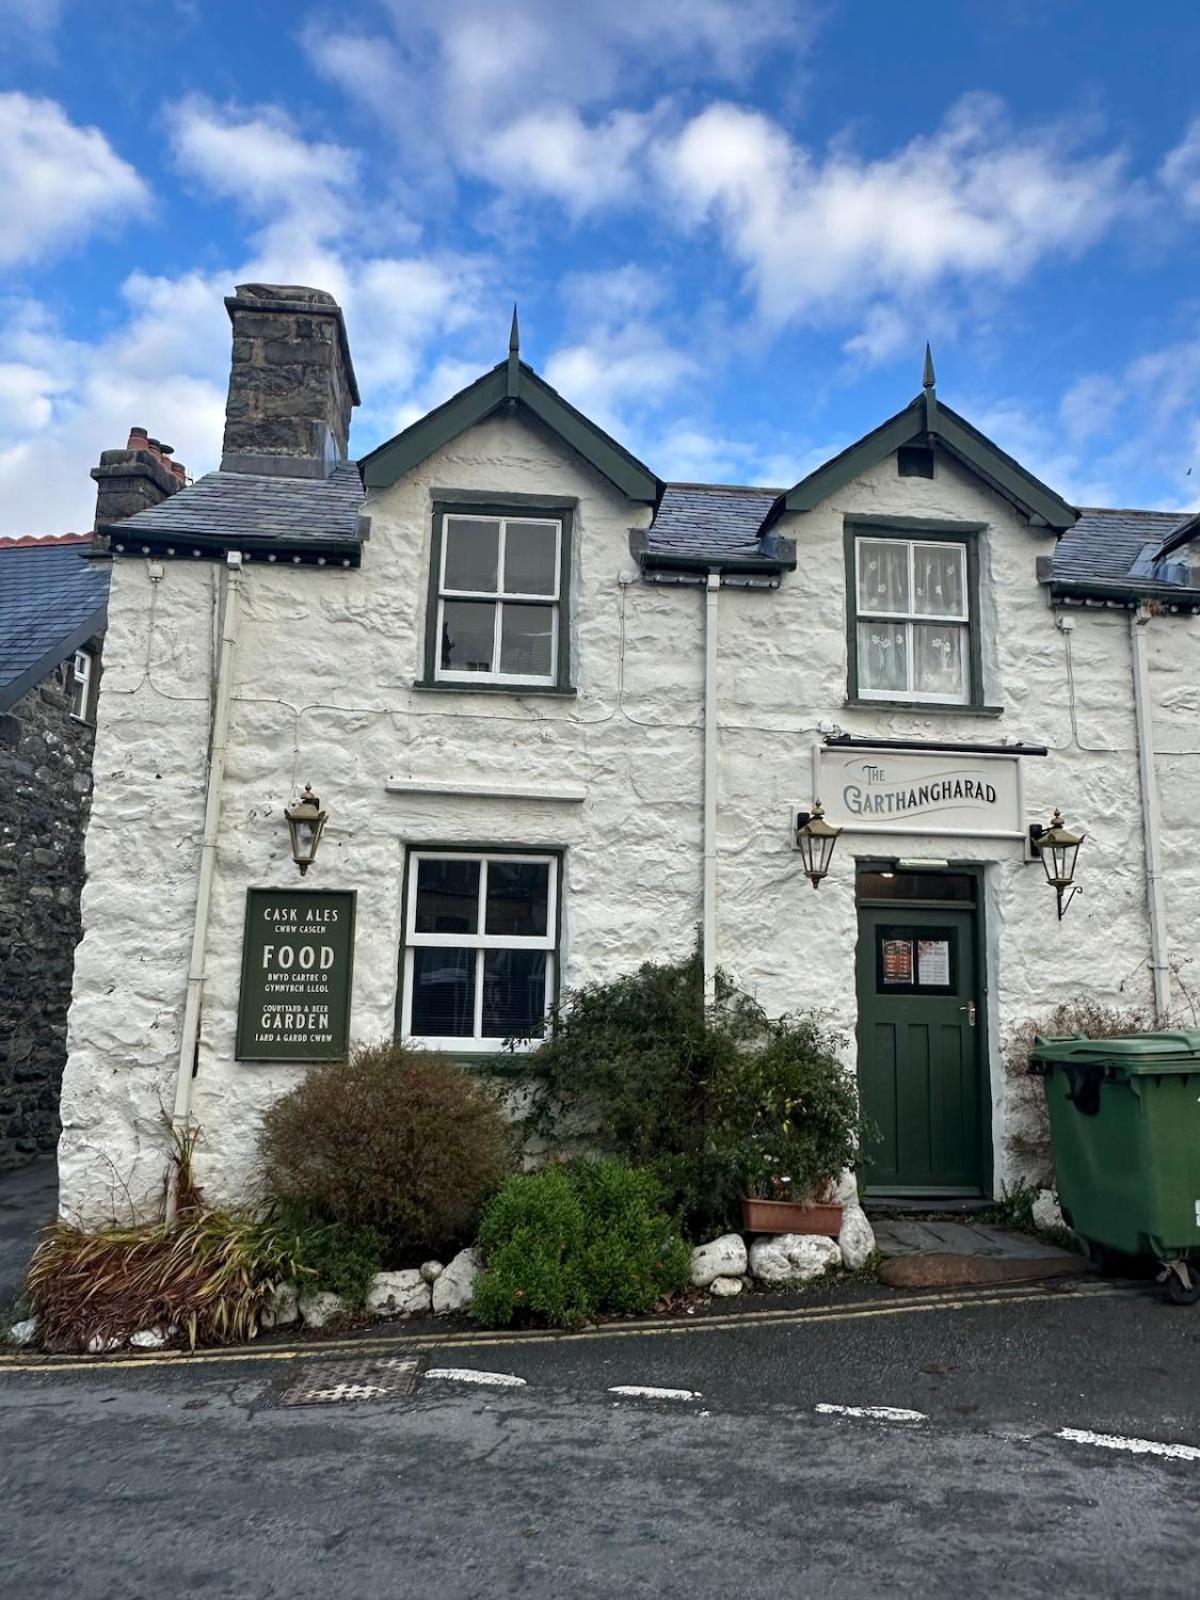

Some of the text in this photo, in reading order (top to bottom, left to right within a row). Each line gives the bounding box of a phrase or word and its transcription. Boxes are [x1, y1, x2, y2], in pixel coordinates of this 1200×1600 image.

[843, 780, 997, 814] GARTHANGHARAD
[264, 908, 339, 922] CASK ALES
[262, 945, 335, 970] FOOD
[267, 973, 290, 982] BWYD
[307, 985, 329, 993] LLEOL
[262, 1004, 302, 1013] COURTYARD
[311, 1005, 329, 1013] BEER
[261, 1013, 329, 1029] GARDEN
[283, 1033, 308, 1042] GARDD
[310, 1033, 333, 1042] CWRW
